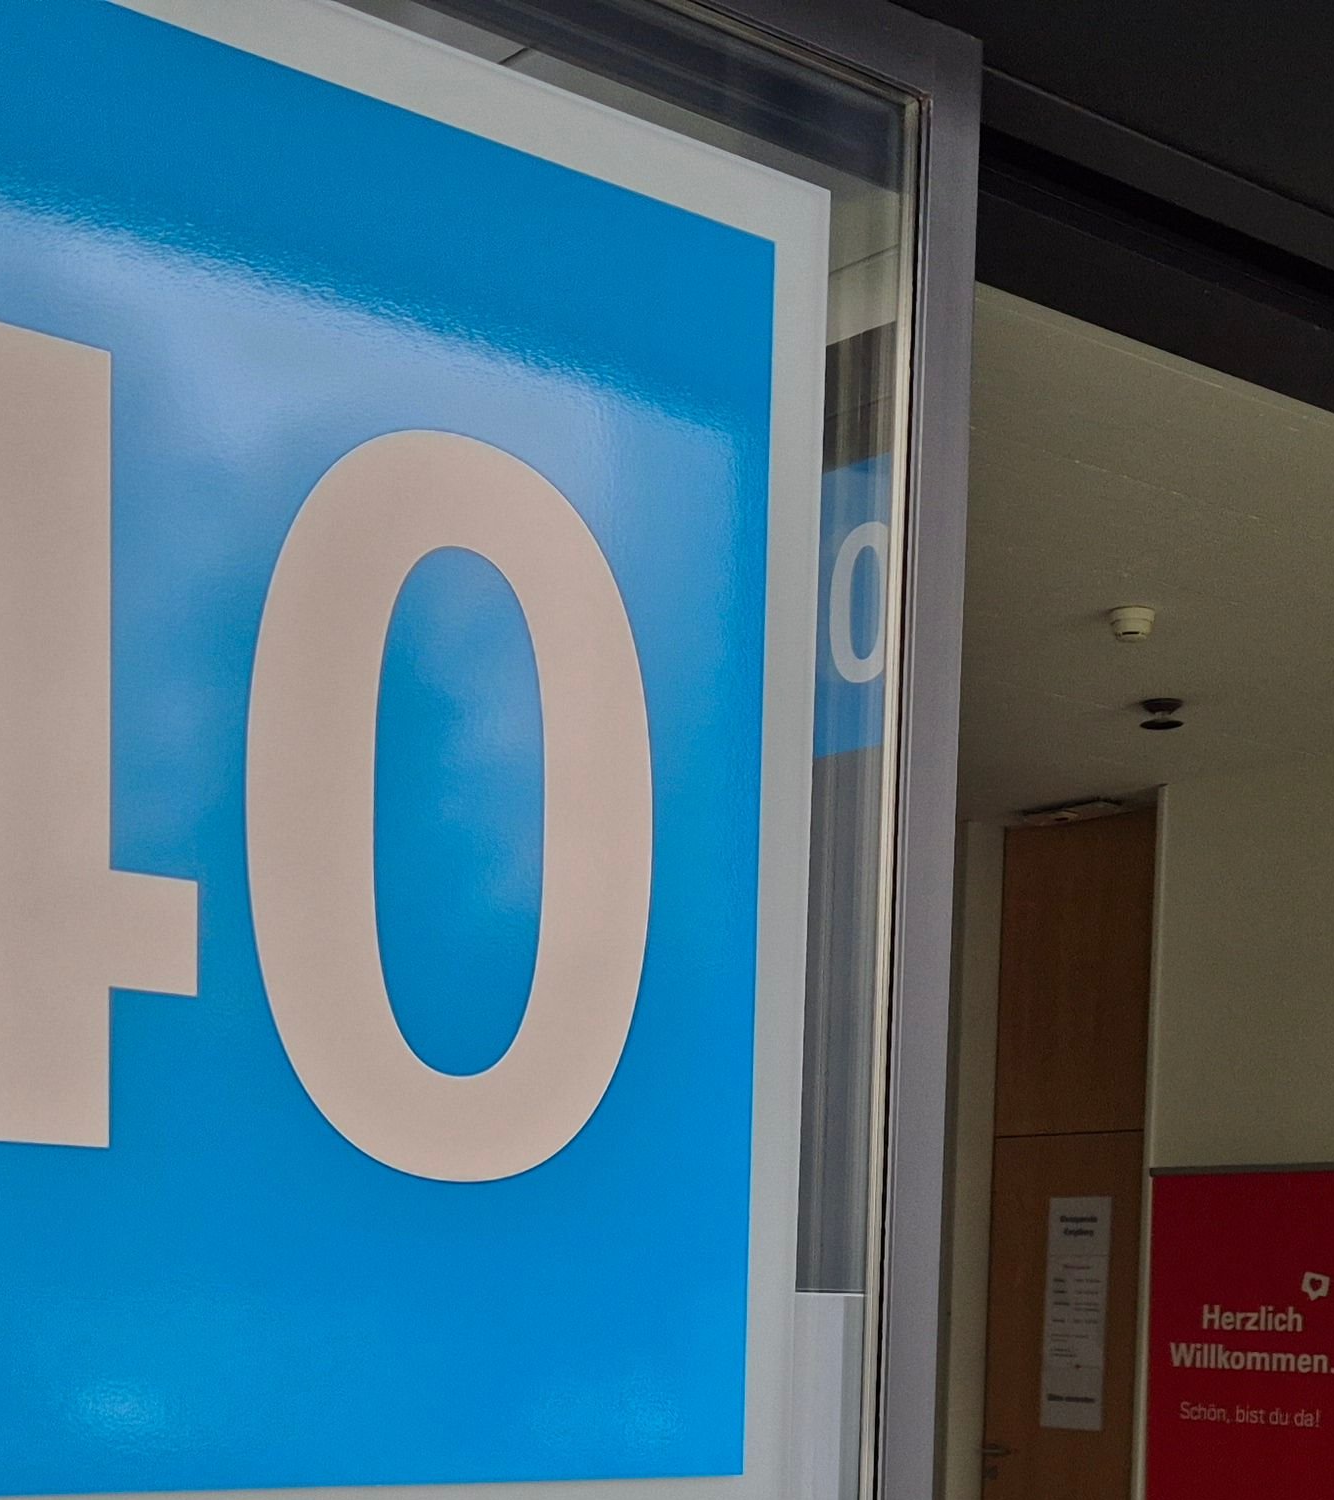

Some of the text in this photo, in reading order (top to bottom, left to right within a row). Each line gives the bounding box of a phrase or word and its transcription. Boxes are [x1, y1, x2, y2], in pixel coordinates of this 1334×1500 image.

[1202, 1304, 1303, 1332] Herzlich
[1180, 1401, 1320, 1428] Schön, bist du da!
